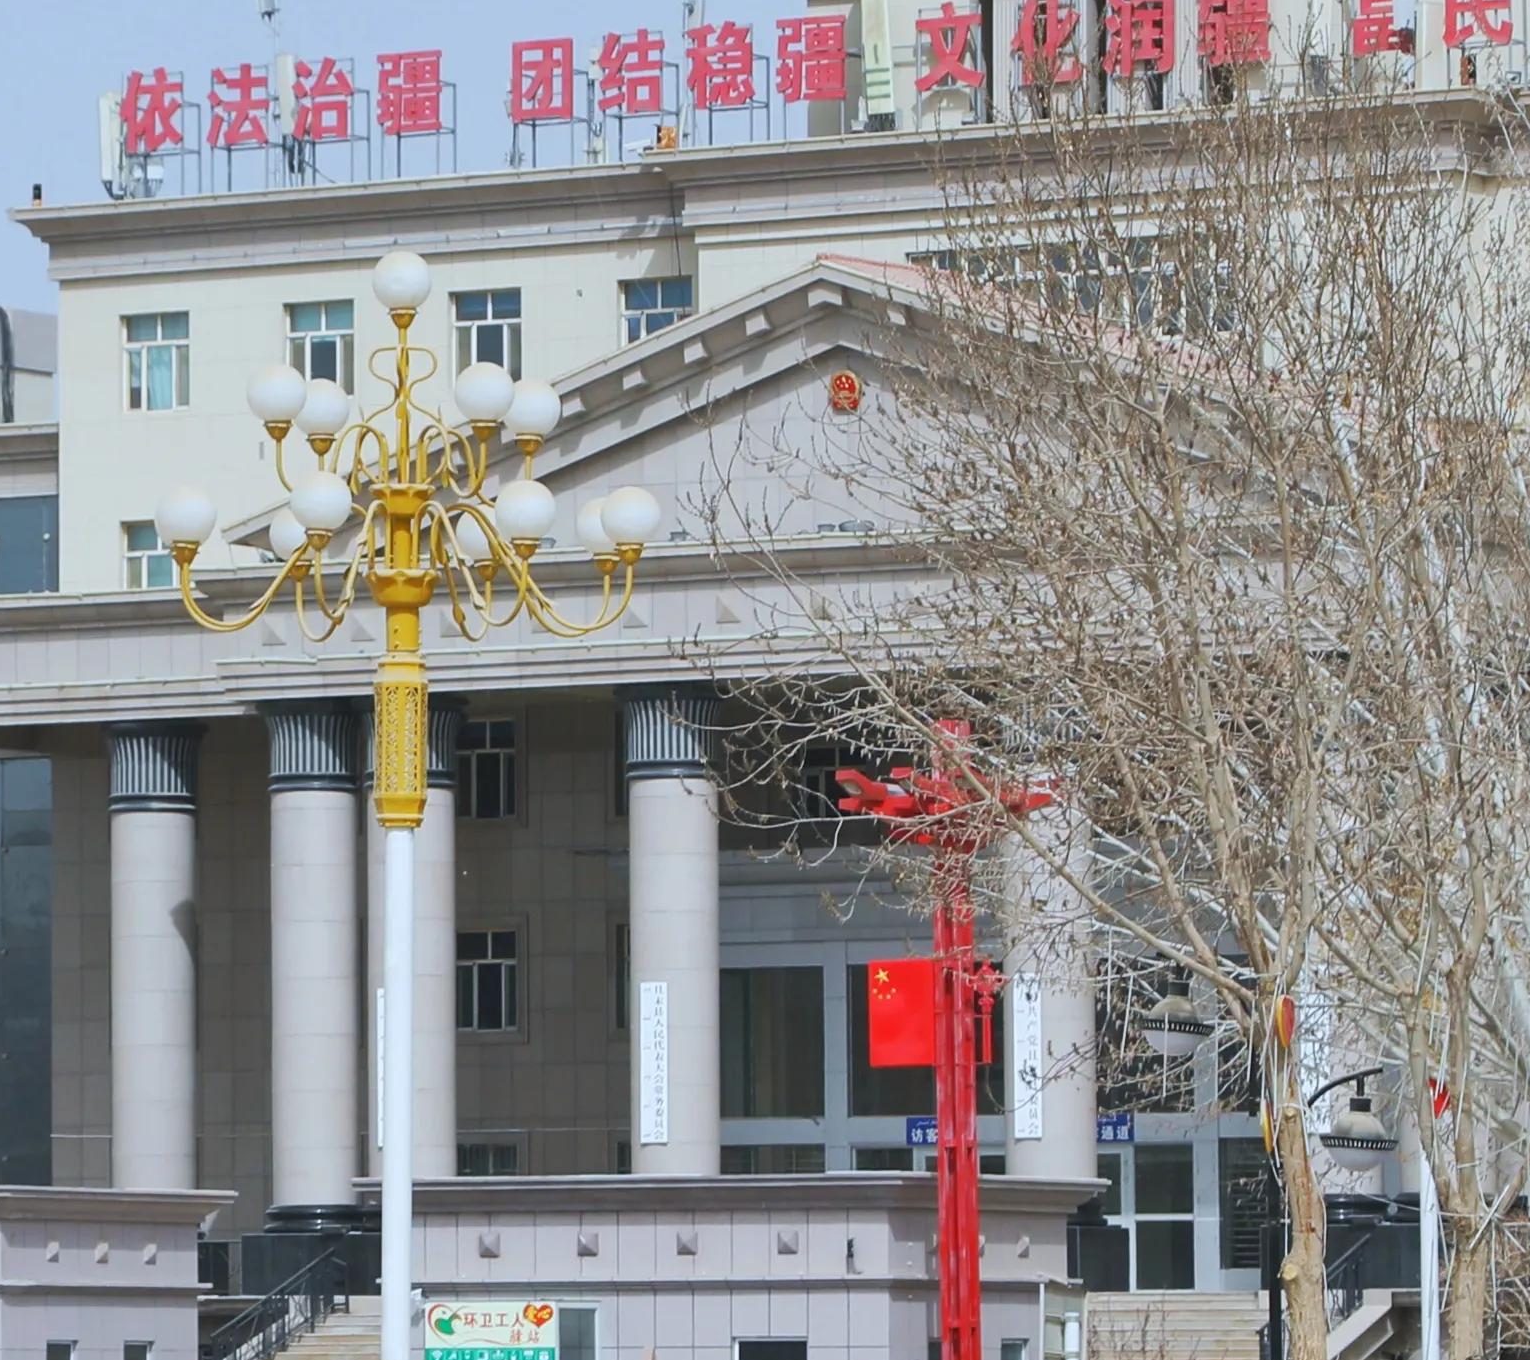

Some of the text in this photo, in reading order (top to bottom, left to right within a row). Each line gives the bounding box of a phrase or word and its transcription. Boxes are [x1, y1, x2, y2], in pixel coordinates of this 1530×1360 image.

[120, 48, 444, 155] 依法治疆
[509, 13, 847, 122] 团结稳疆
[463, 1312, 525, 1328] 环卫工人
